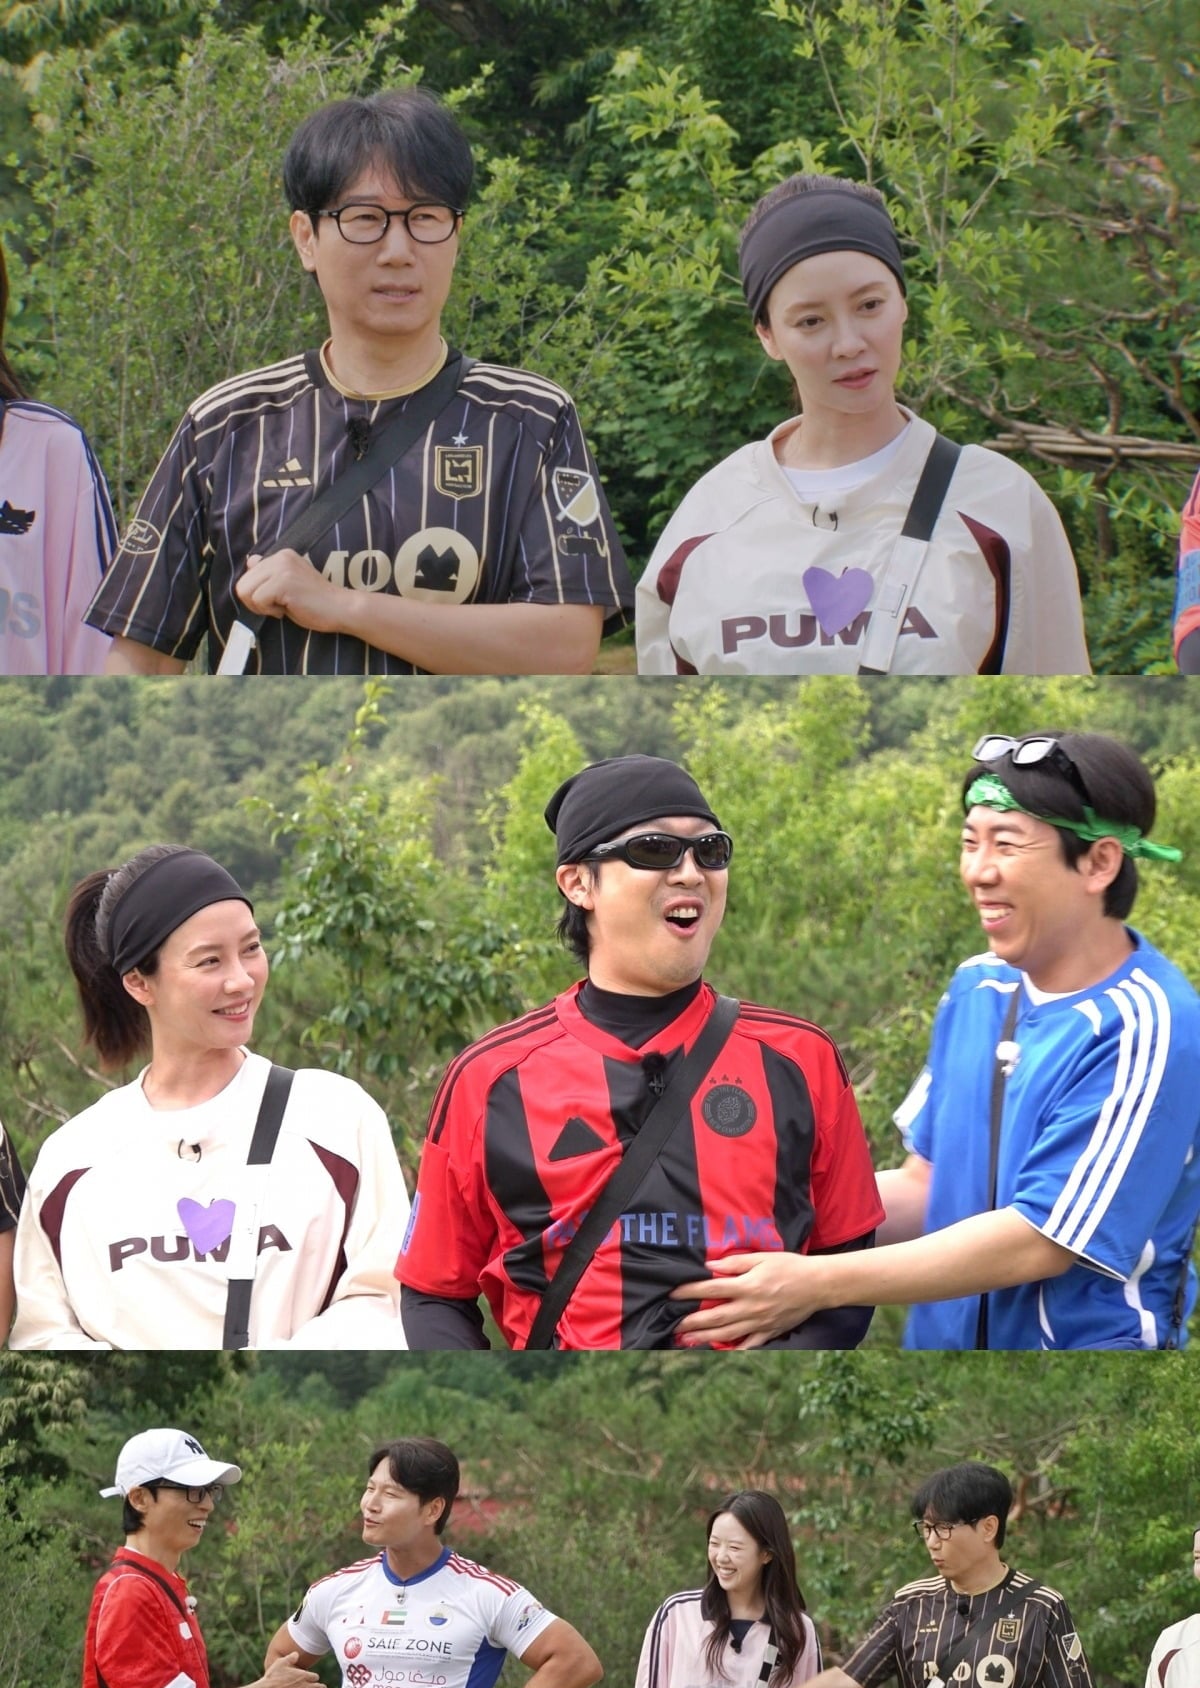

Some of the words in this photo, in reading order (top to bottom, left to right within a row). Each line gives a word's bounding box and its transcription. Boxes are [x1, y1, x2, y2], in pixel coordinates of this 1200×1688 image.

[619, 1212, 678, 1246] THE
[686, 1214, 783, 1249] FLAME
[367, 1636, 402, 1650] SAIF
[405, 1639, 453, 1655] ZONE
